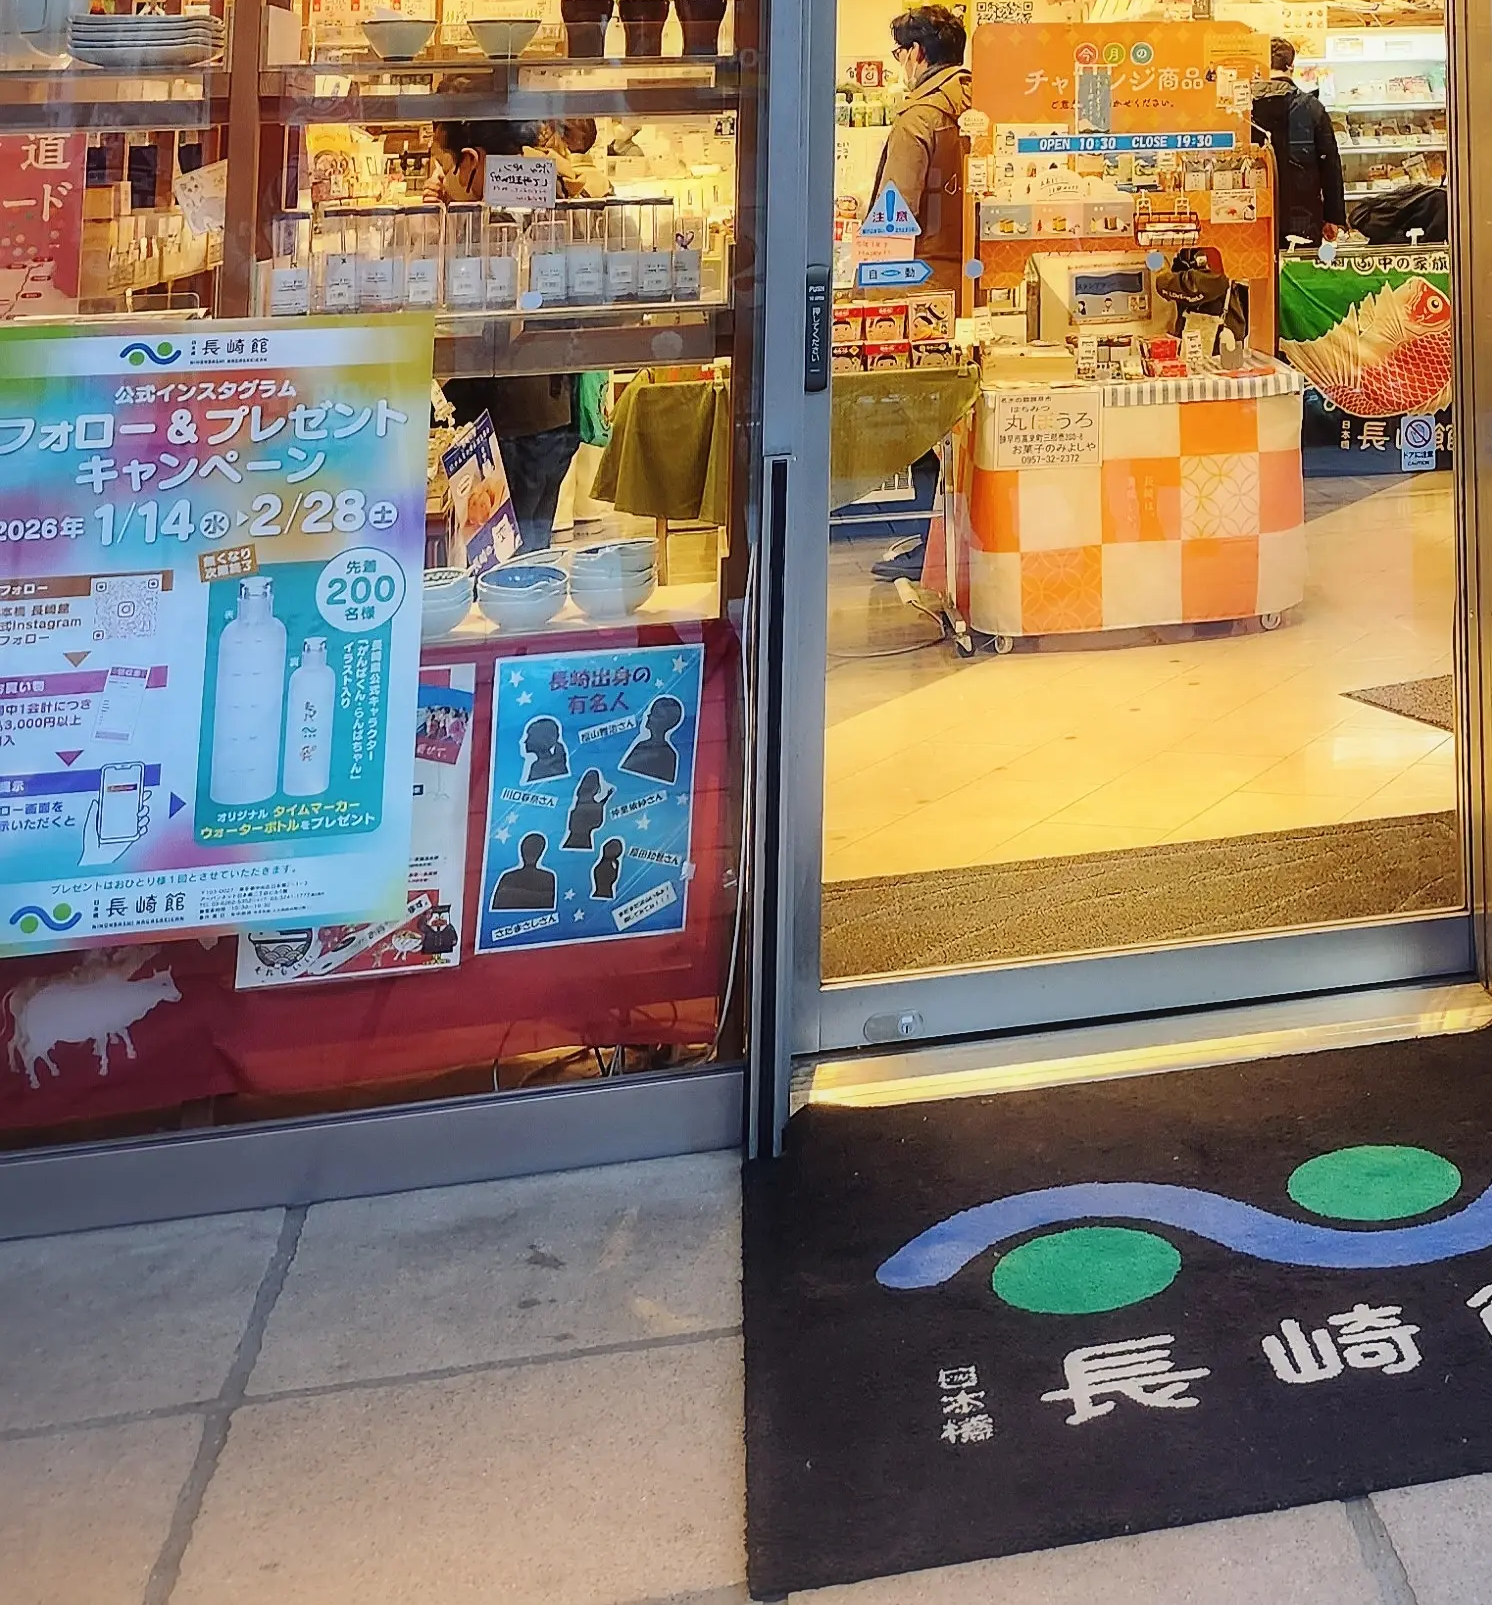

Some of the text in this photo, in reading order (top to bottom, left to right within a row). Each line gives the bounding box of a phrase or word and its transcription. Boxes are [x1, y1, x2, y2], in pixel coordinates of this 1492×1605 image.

[1078, 46, 1148, 62] 今月の
[1039, 134, 1213, 151] OPEN 10:30 CLOSE 19:30
[201, 337, 270, 356] 長崎館
[114, 379, 297, 406] 公式インスタグラム
[1005, 412, 1093, 431] 丸ぼうろ
[1013, 442, 1096, 454] お菓子のみよしや
[1358, 421, 1454, 452] 長館
[74, 448, 326, 494] キャンペーン
[1021, 454, 1079, 464] 0957-32-2372
[0, 516, 85, 542] 2026年
[93, 498, 196, 546] 1/14
[248, 489, 366, 537] 2/28
[345, 560, 377, 574] 先着
[326, 575, 396, 606] 200
[344, 605, 375, 621] 名様
[549, 665, 651, 691] 長崎出身の
[567, 691, 630, 715] 有名人
[217, 801, 361, 823] オリジナル タイムマーカー
[200, 813, 375, 840] ウォーターボトルをプレゼント
[106, 892, 186, 917] 長崎館
[938, 1365, 994, 1443] 日本橋
